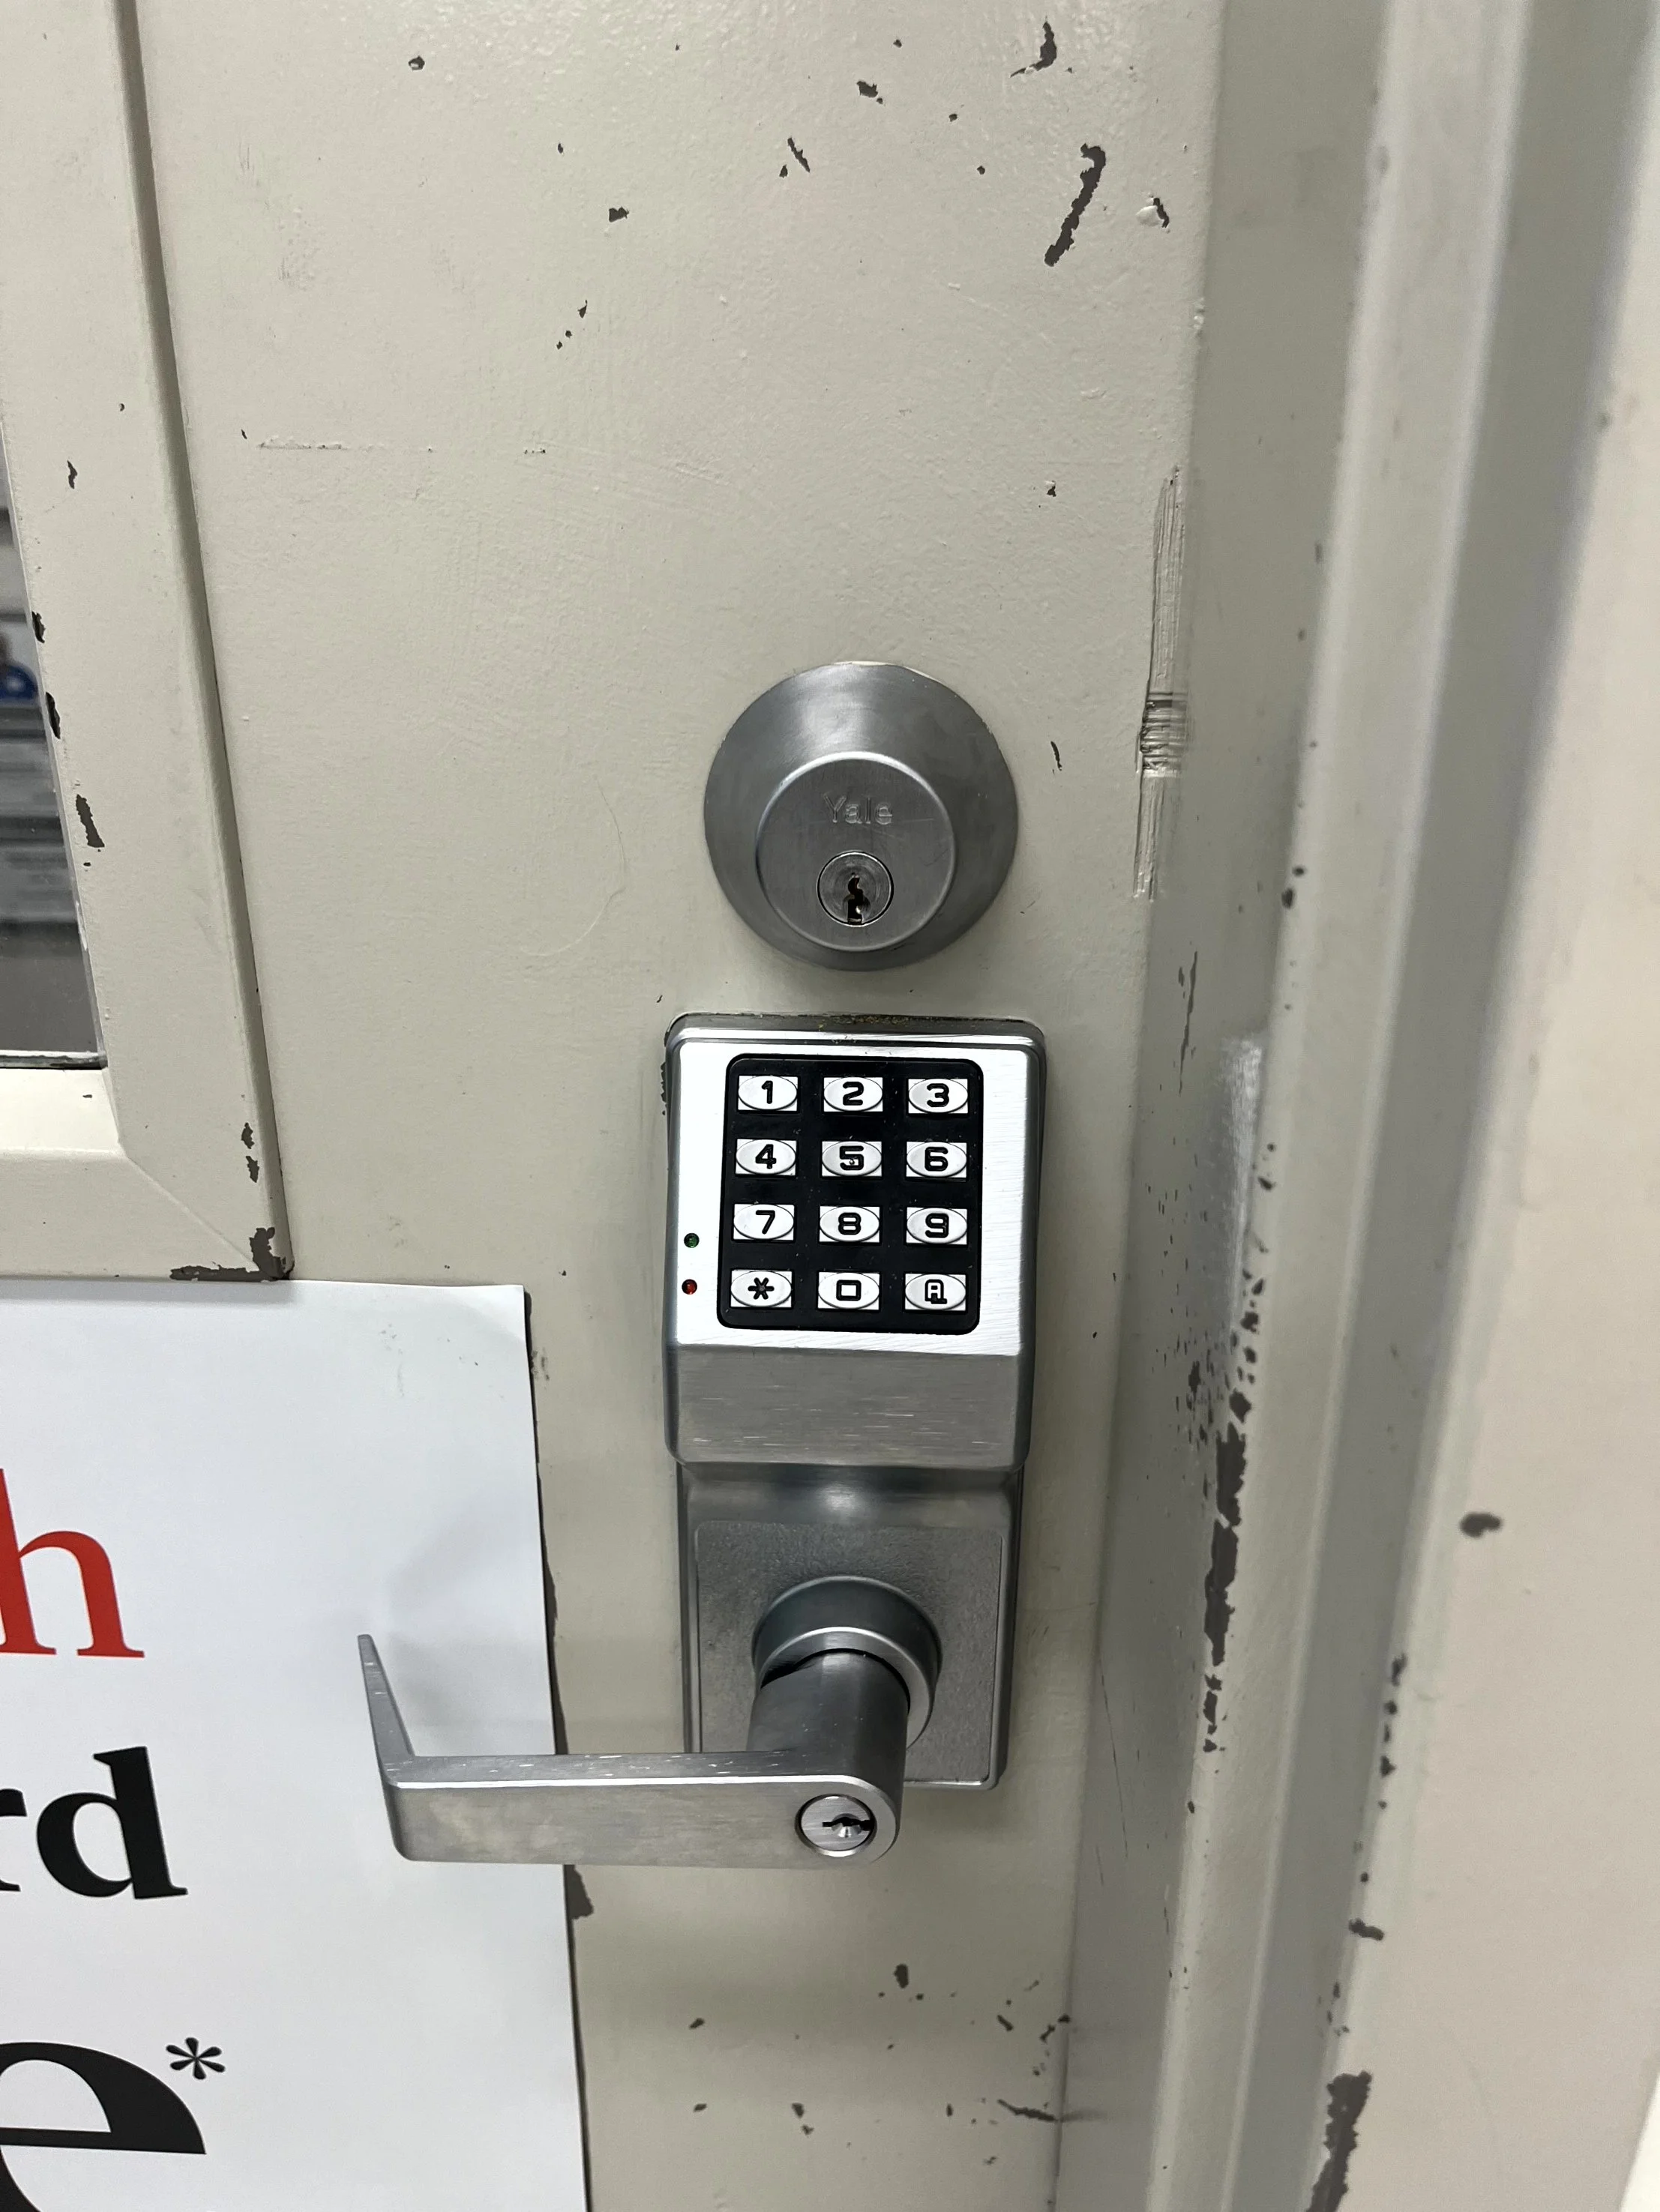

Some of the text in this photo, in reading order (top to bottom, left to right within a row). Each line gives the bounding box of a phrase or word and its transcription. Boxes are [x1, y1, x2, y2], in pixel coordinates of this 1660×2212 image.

[823, 793, 893, 825] Yale
[761, 1080, 950, 1108] 1 2 3
[755, 1144, 948, 1172] 4 5 6
[754, 1209, 949, 1239] 7 8 9
[835, 1279, 862, 1302] 0
[0, 1468, 145, 1658] h
